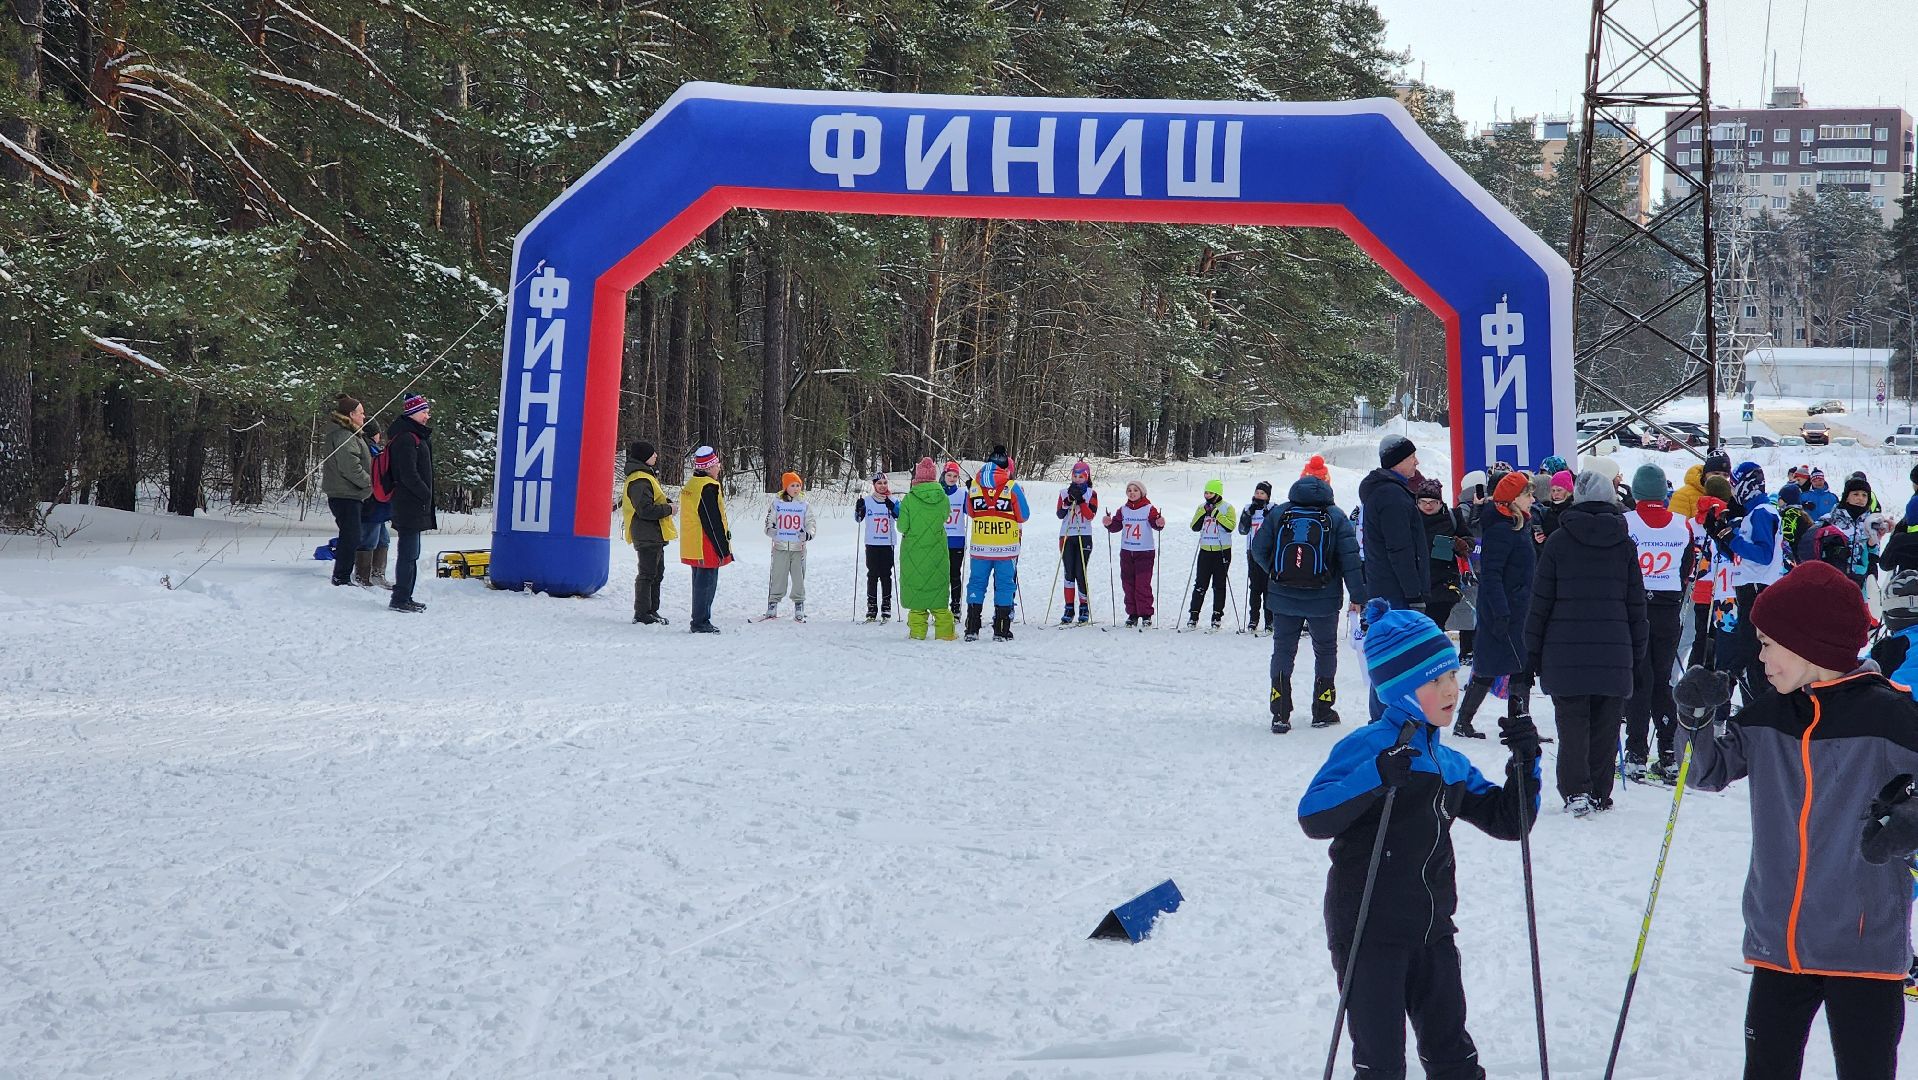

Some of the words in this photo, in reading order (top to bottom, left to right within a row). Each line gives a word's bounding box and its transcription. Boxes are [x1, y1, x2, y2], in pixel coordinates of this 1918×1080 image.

[809, 112, 1244, 197] ФИНИШ
[1480, 302, 1530, 474] ФИН
[511, 266, 570, 533] ФИНИШ
[777, 514, 801, 530] 109
[873, 517, 889, 533] 73
[973, 520, 1011, 535] ТРЕНЕР
[1124, 523, 1142, 540] 74
[1639, 551, 1672, 576] 92
